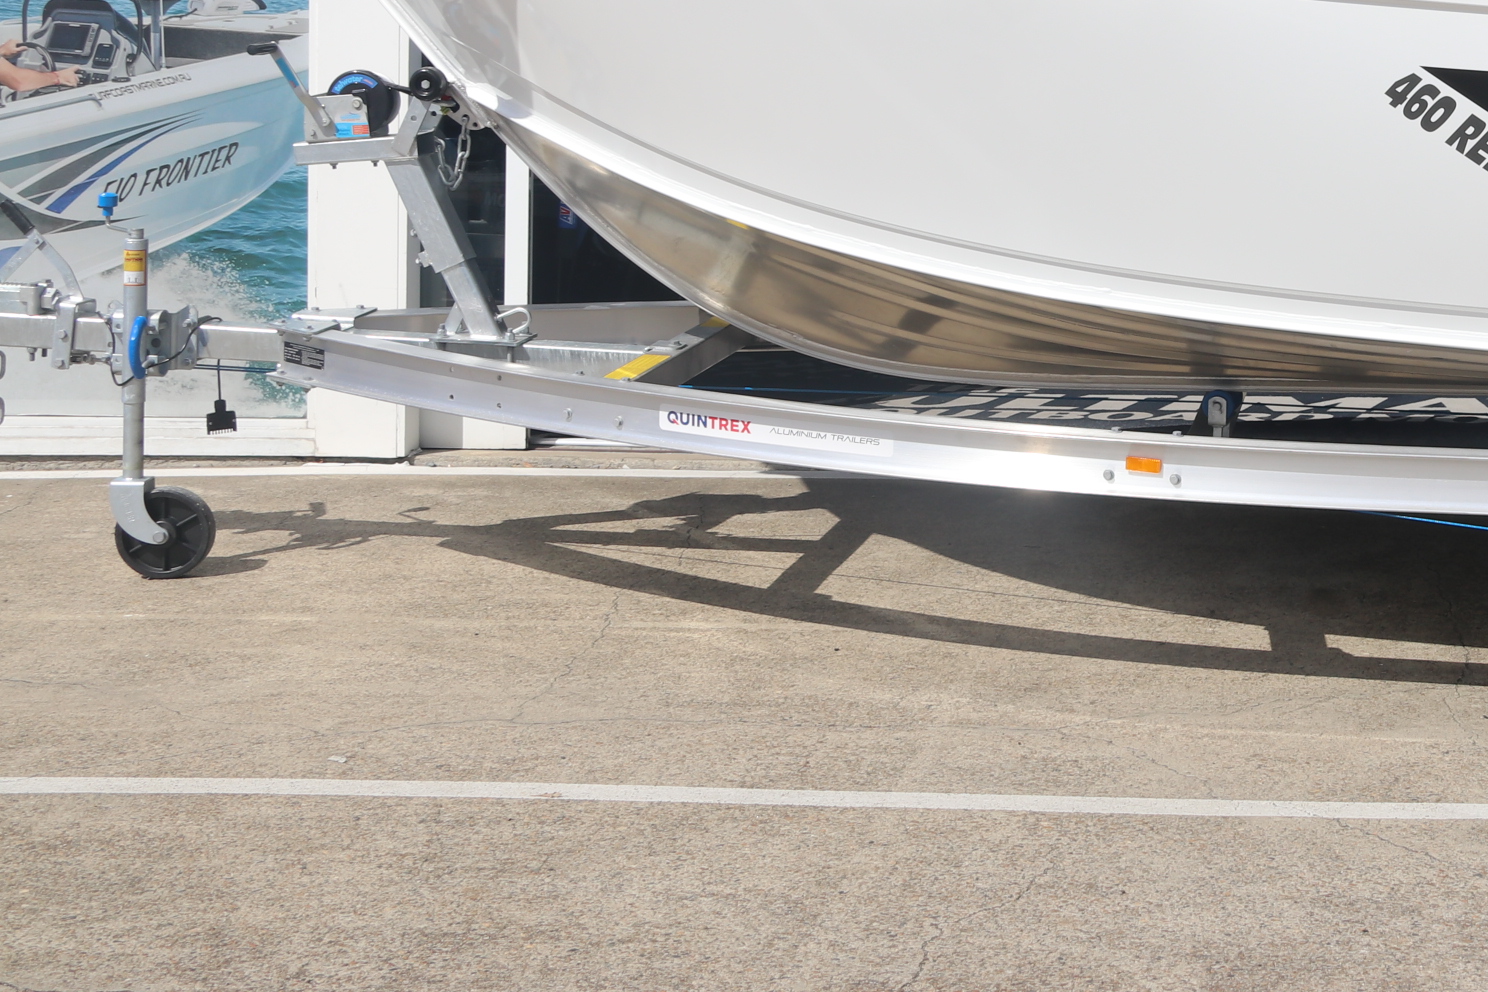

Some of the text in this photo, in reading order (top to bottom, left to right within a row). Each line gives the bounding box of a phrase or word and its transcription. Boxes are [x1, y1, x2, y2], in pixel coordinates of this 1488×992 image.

[1384, 72, 1458, 133] 460
[138, 141, 240, 197] FRONTIER
[667, 410, 881, 446] QUINTREX ALUMINIUM TRAILERS
